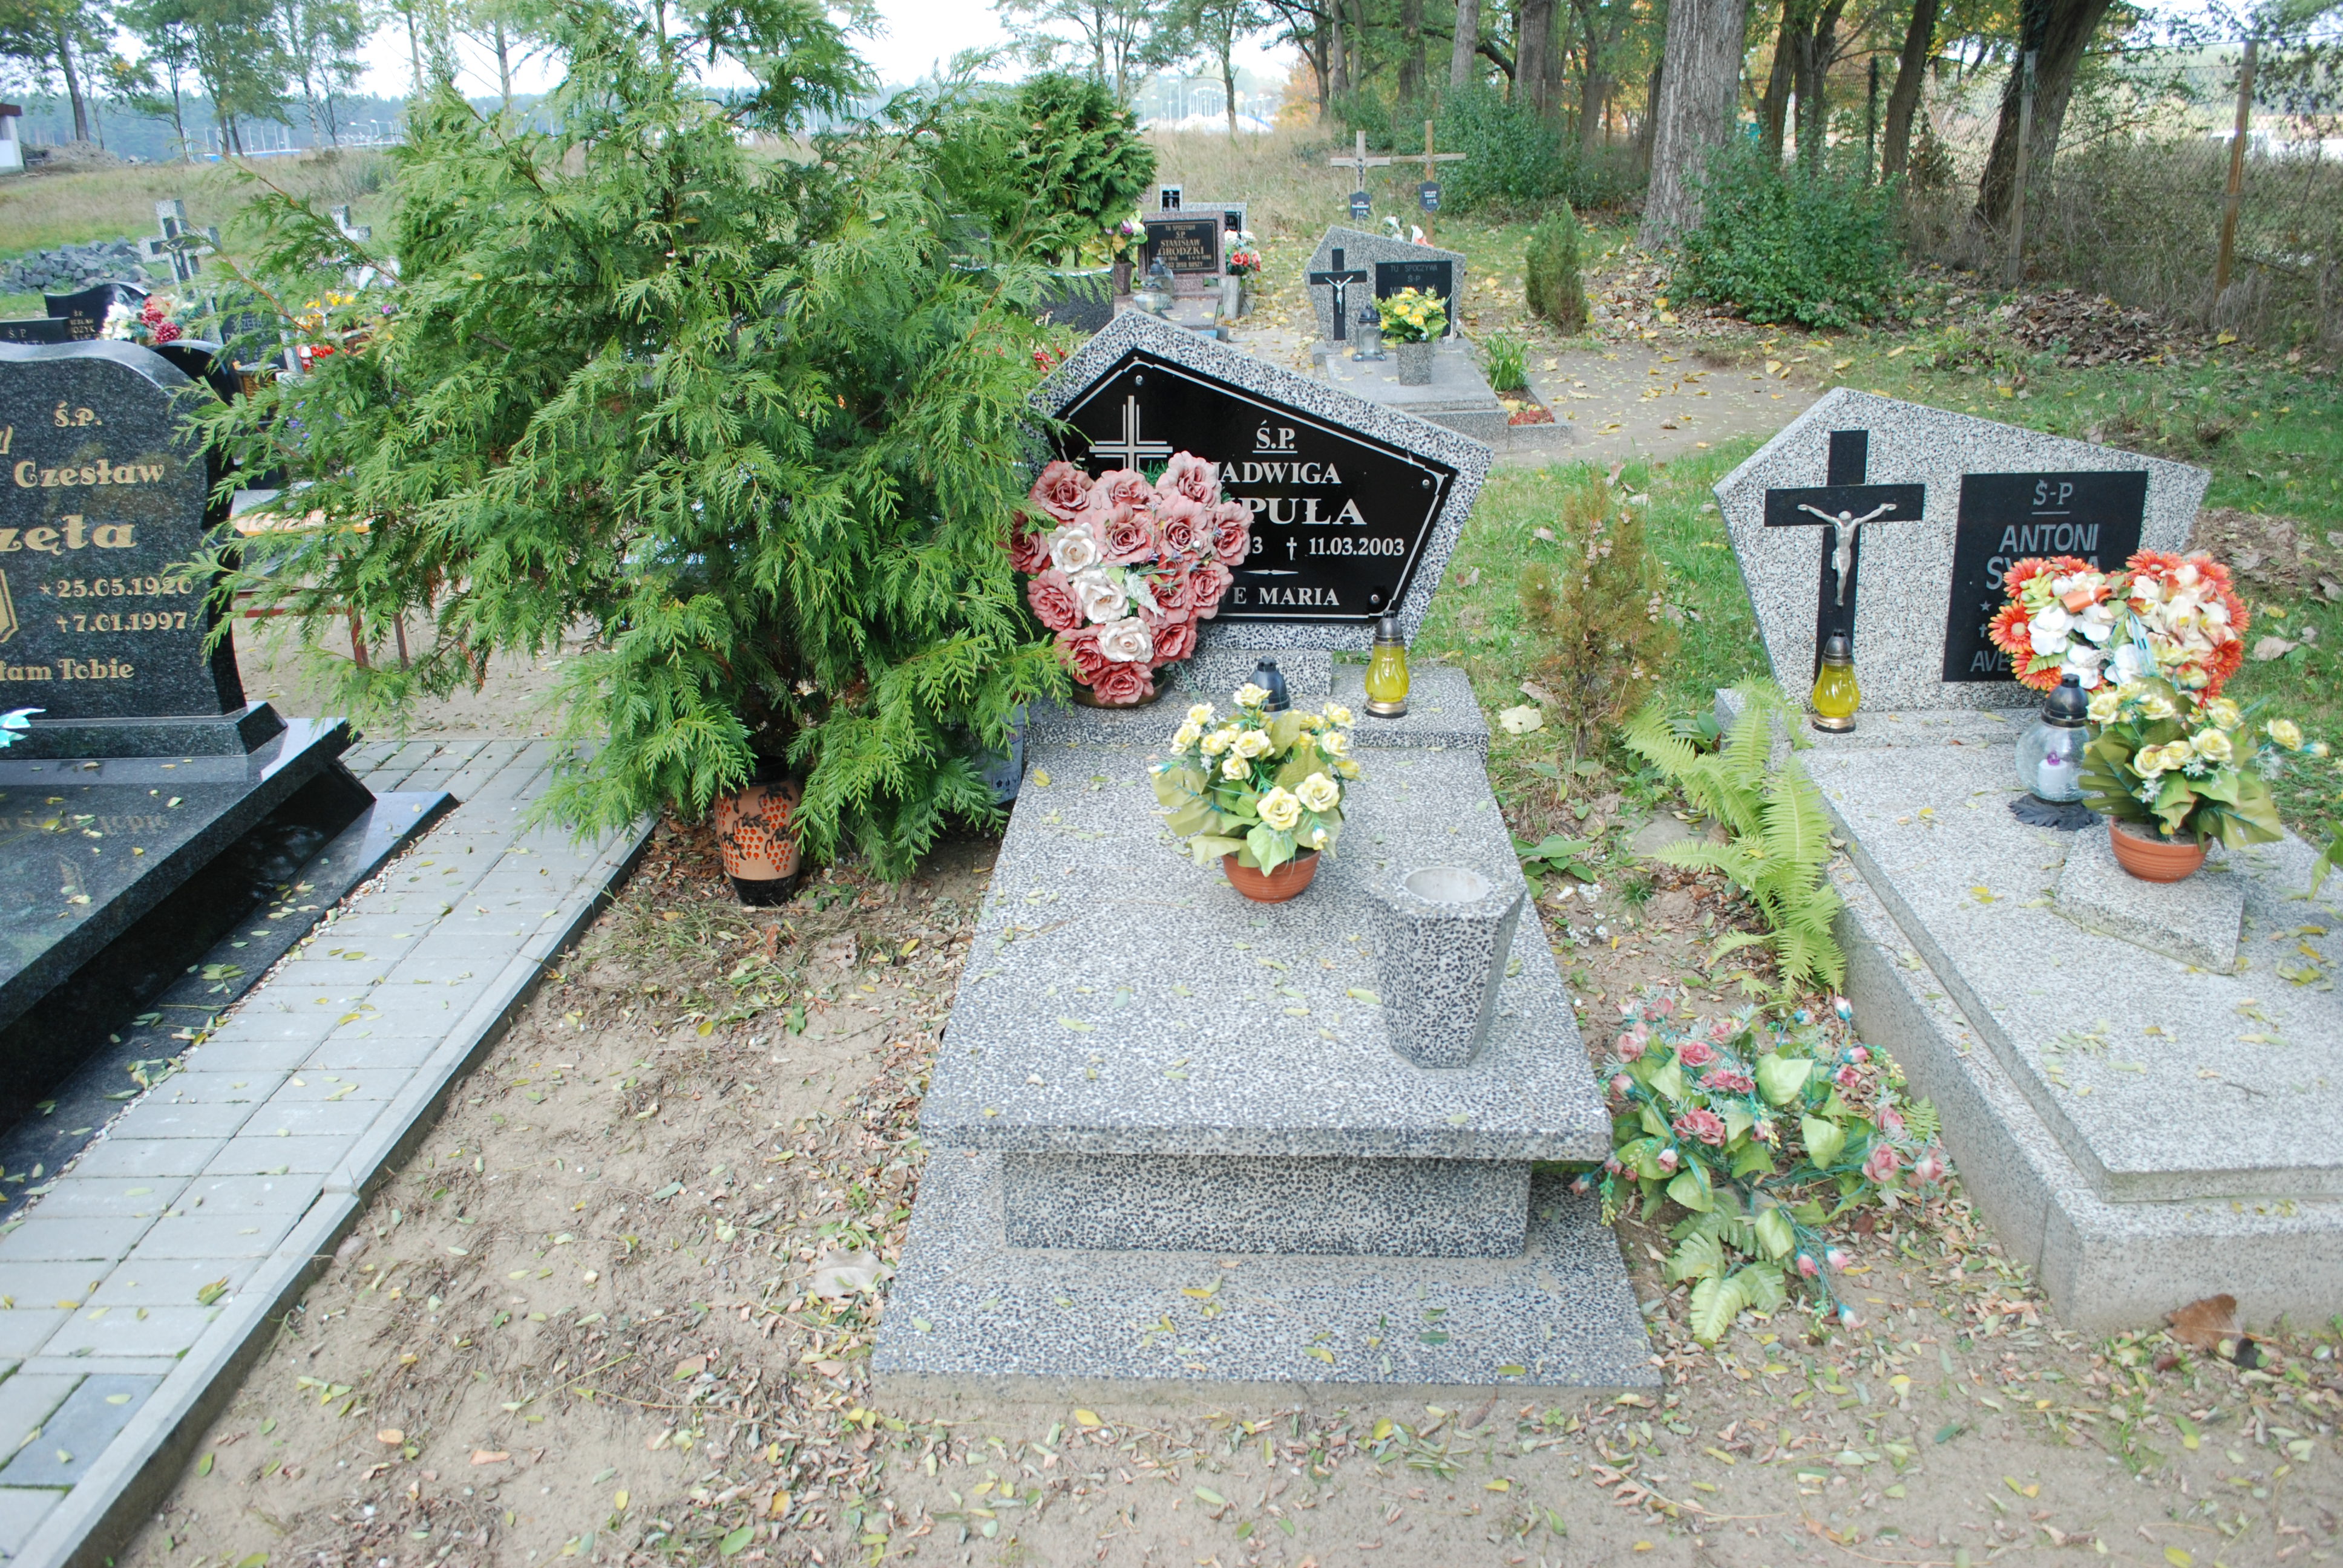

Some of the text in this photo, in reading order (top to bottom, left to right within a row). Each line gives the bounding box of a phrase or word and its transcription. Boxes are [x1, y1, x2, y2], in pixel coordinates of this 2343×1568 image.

[1158, 246, 1204, 256] GRODZKI
[54, 401, 102, 427] Ś.P.
[1256, 419, 1296, 449] Ś.P.
[15, 459, 165, 488] Czesław
[1231, 497, 1368, 525] PUŁA
[1308, 537, 1405, 557] 11.03.2003
[1998, 523, 2099, 552] ANTONI
[57, 577, 194, 598] 25.05.1920
[1258, 587, 1340, 606] MARIA
[73, 611, 188, 632] 7.01.1997
[57, 658, 135, 680] Tobie
